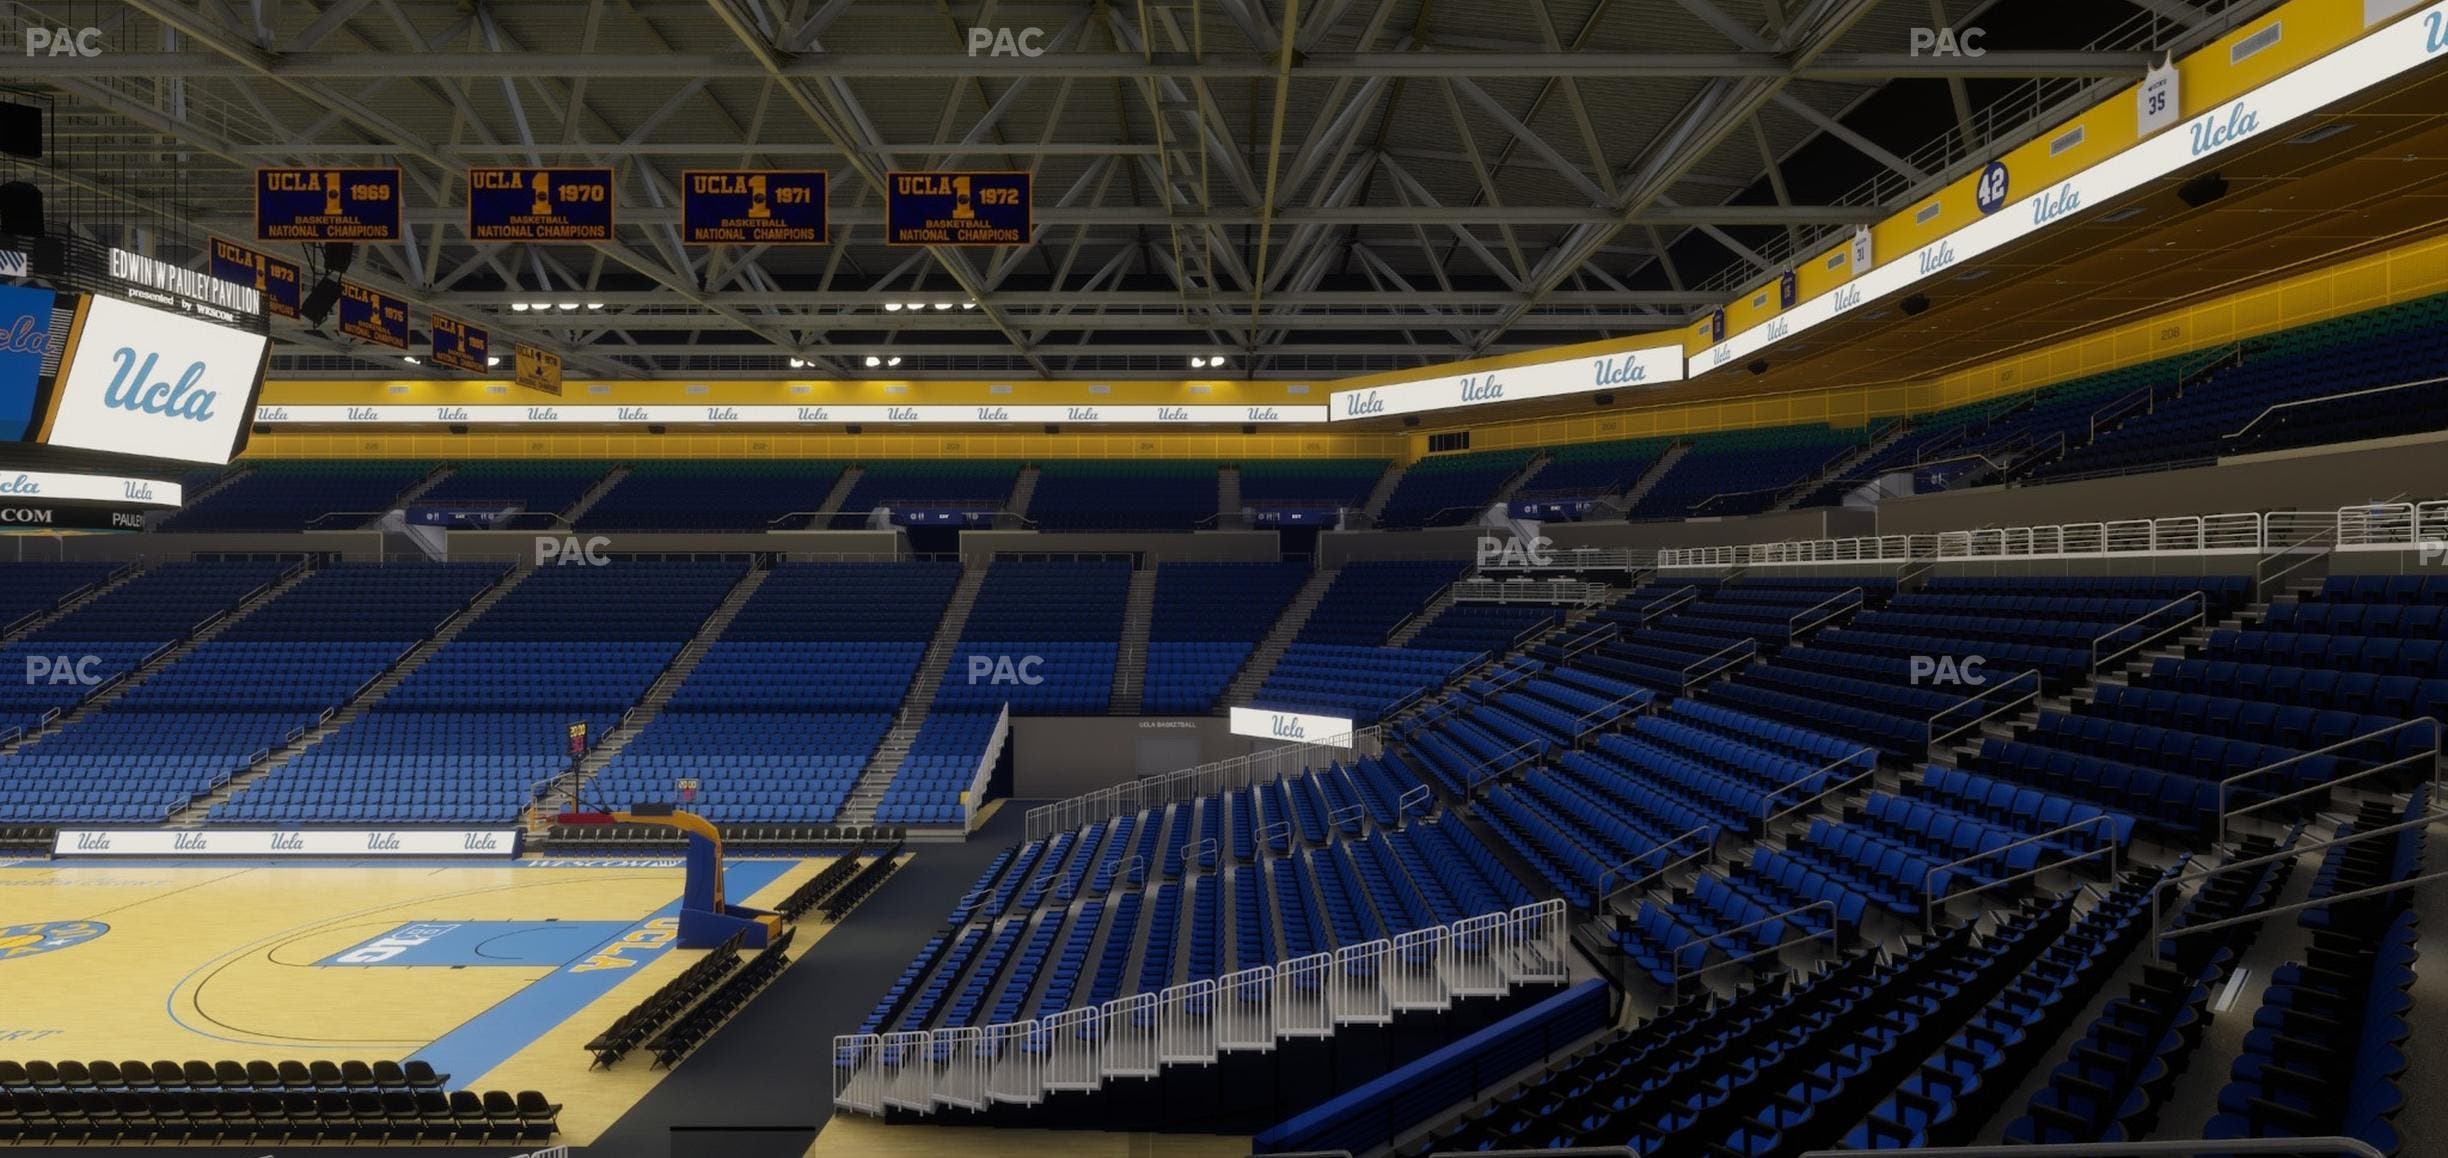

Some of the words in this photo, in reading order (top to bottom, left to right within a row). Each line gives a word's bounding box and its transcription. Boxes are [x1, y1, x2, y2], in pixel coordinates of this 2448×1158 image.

[2149, 91, 2165, 115] 35
[267, 173, 321, 191] UCLA
[350, 184, 392, 200] 1969
[472, 172, 523, 189] UCLA
[558, 184, 604, 202] 1970
[693, 176, 748, 194] UCLA
[775, 187, 811, 203] 1971
[898, 176, 951, 195] UCLA
[979, 188, 1019, 205] 1972
[1978, 167, 2005, 206] 42
[268, 226, 319, 237] NATIONAL
[327, 226, 388, 237] CHAMPIONS
[295, 216, 361, 225] BASKETBALL
[477, 226, 534, 237] NATIONAL
[536, 226, 605, 237] CHAMPIONS
[510, 216, 568, 225] BASKETBALL
[721, 218, 787, 228] BASKETBALL
[926, 219, 990, 229] BASKETBALL
[1767, 317, 1788, 342] Ucla
[1835, 284, 1860, 312] Ucla
[1920, 241, 1954, 274] Ucla
[2033, 183, 2080, 225] Ucla
[2191, 102, 2259, 156] Ucla
[695, 229, 746, 241] NATIONAL
[753, 229, 815, 241] CHAMPIONS
[900, 229, 949, 241] NATIONAL
[958, 230, 1019, 241] CHAMPIONS
[217, 243, 253, 267] UCLA
[270, 266, 294, 283] 1973
[110, 247, 152, 286] EDWIN
[153, 258, 166, 290] W
[168, 263, 210, 302] PAULEY
[211, 275, 260, 316] PAVILION
[129, 288, 174, 305] presented
[181, 298, 192, 312] by
[197, 304, 233, 322] WESCOM
[104, 347, 217, 422] Ucla
[1348, 391, 1384, 415] Ucla
[1461, 375, 1503, 402] Ucla
[1594, 355, 1646, 385] Ucla
[258, 408, 287, 420] Ucla
[349, 408, 377, 420] Ucla
[438, 408, 467, 420] Ucla
[528, 408, 557, 420] Ucla
[619, 408, 648, 420] Ucla
[708, 408, 737, 420] Ucla
[799, 408, 828, 420] Ucla
[888, 408, 917, 420] Ucla
[978, 408, 1007, 420] Ucla
[1069, 408, 1097, 420] Ucla
[1159, 408, 1187, 420] Ucla
[1249, 408, 1278, 420] Ucla
[124, 480, 152, 500] Ucla
[1272, 715, 1304, 739] Ucla
[78, 833, 110, 849] Ucla
[175, 833, 207, 849] Ucla
[271, 833, 303, 849] Ucla
[368, 833, 400, 849] Ucla
[465, 833, 497, 849] Ucla
